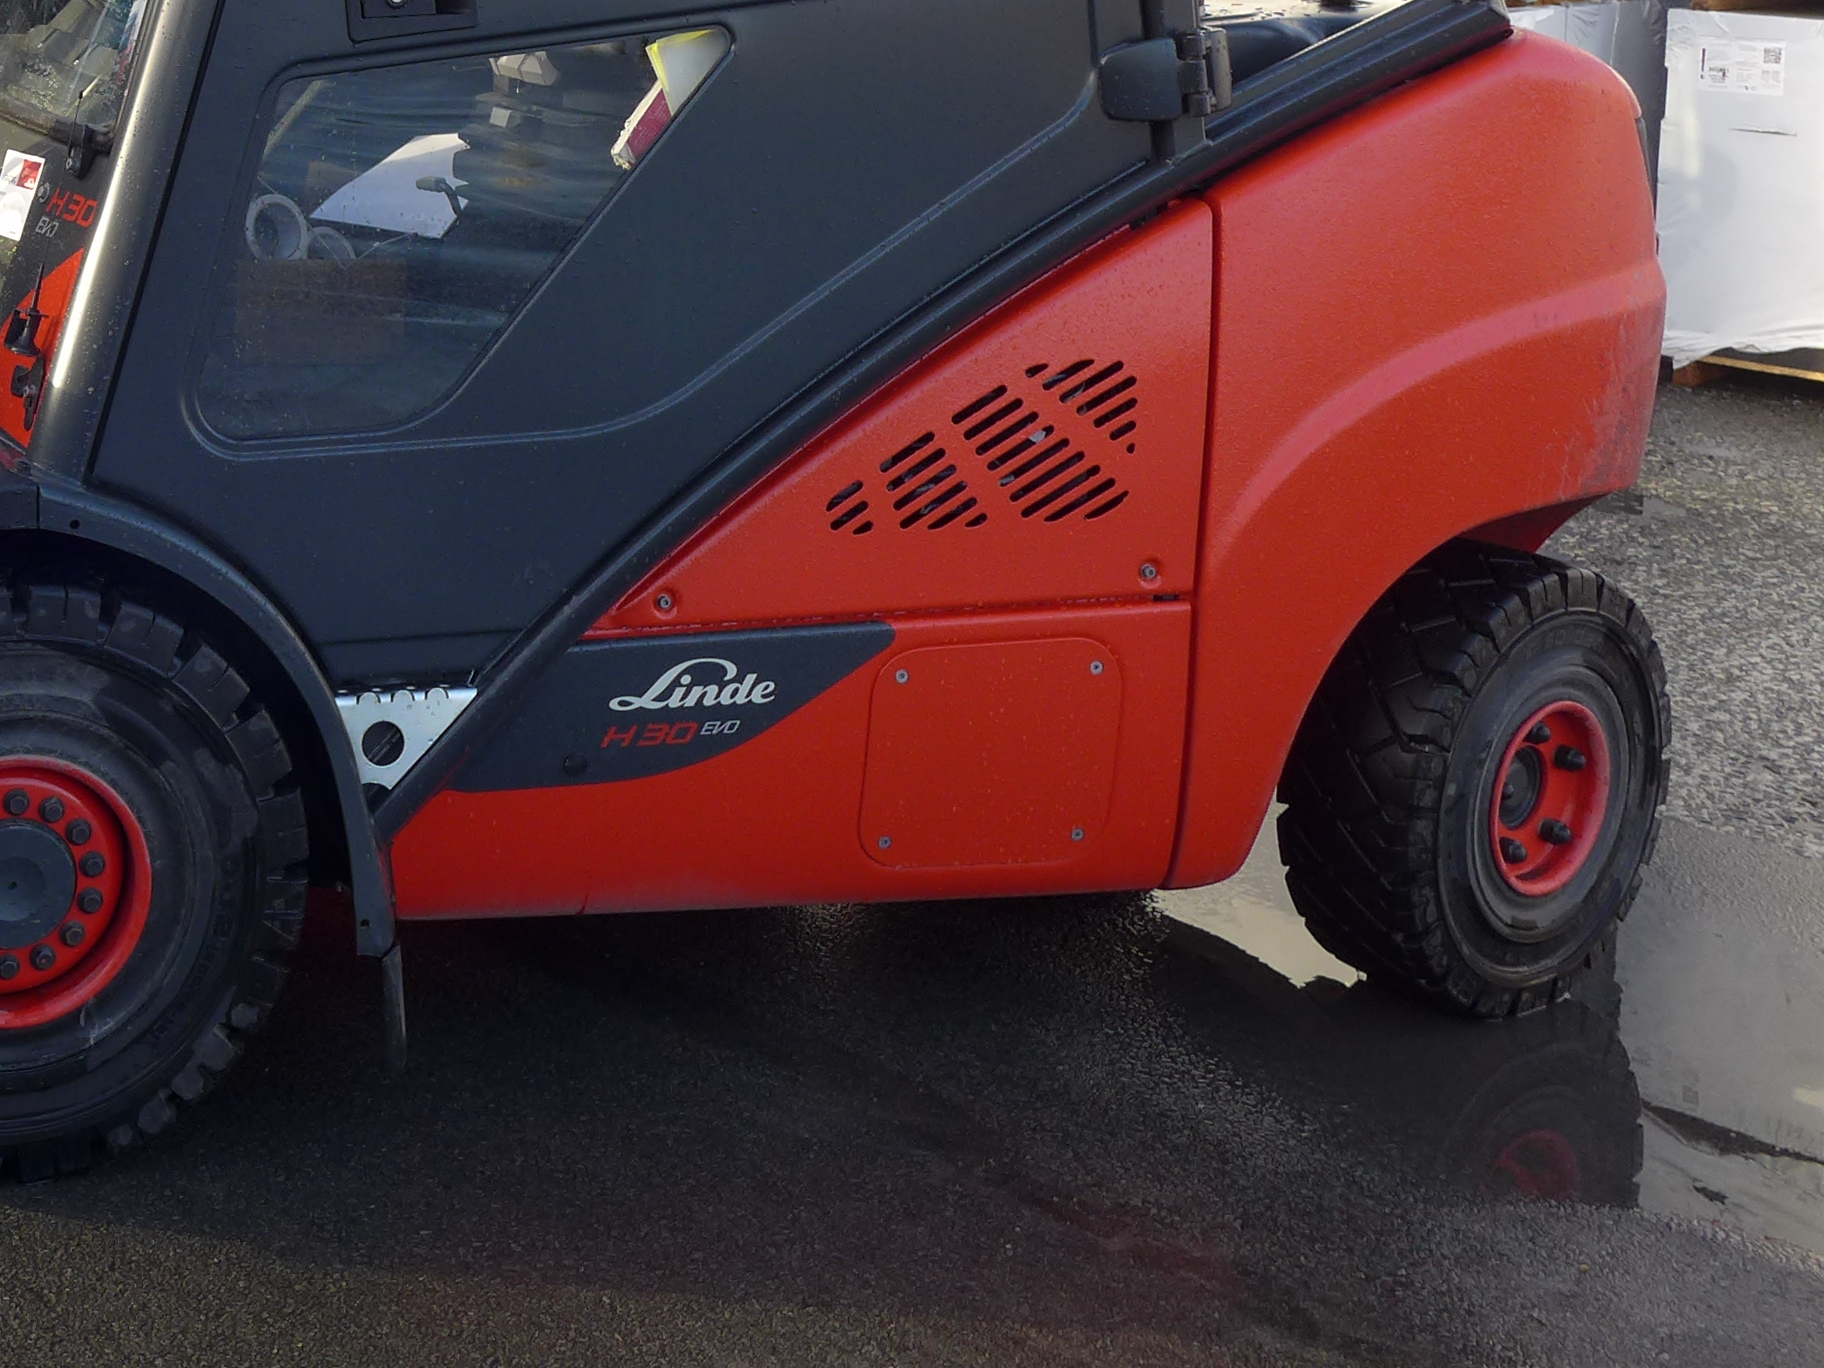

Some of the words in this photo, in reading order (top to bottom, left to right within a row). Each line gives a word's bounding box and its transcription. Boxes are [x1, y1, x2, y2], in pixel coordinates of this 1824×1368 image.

[45, 186, 98, 228] H30
[35, 215, 60, 238] EVO
[608, 657, 776, 711] Linde
[600, 721, 698, 748] H30
[700, 719, 741, 736] EVO
